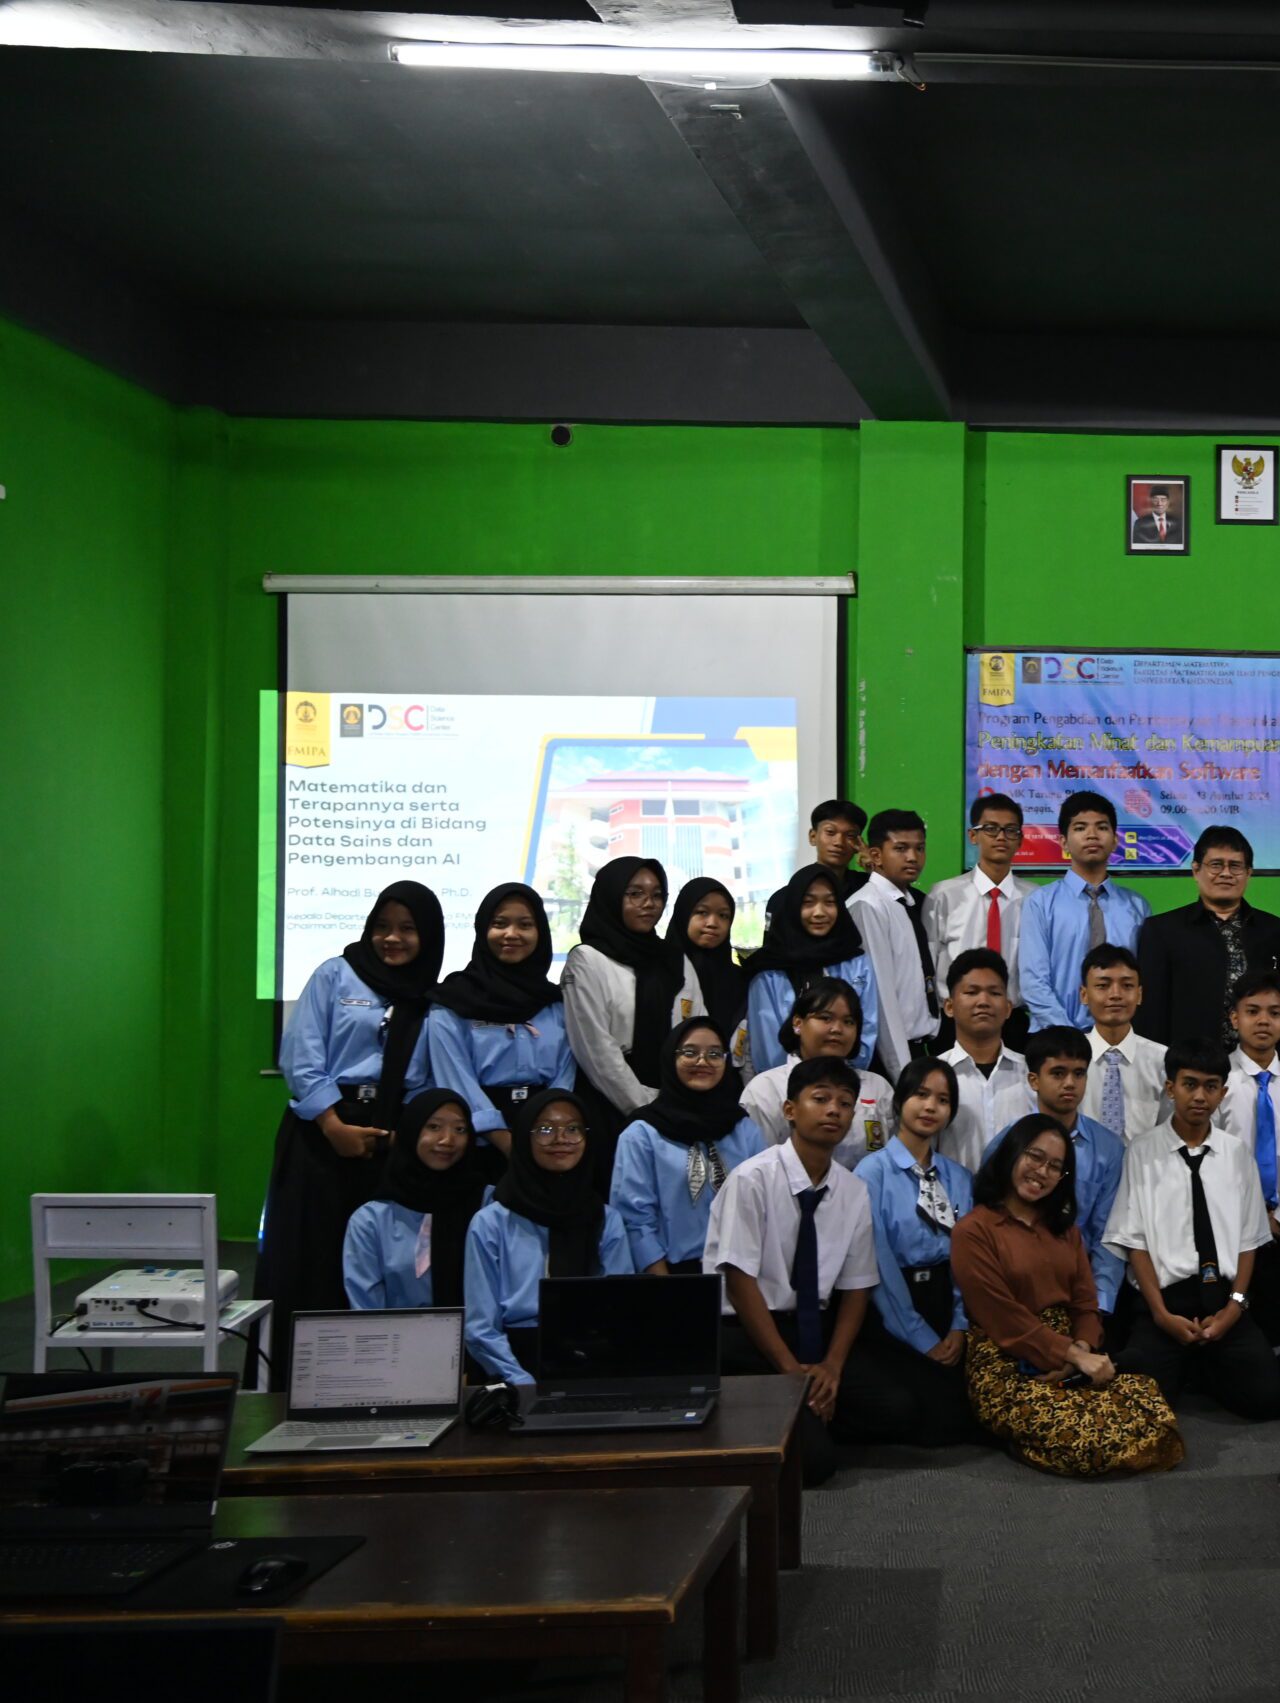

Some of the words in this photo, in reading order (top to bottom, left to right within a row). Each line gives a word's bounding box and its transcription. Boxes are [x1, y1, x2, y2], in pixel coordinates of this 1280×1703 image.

[1044, 657, 1096, 679] DSC
[982, 688, 1012, 697] FMIPA
[367, 704, 425, 731] DSC
[978, 712, 1029, 727] Program
[288, 745, 327, 757] FMIPA
[977, 731, 1085, 756] Peningkatan
[1089, 732, 1139, 751] Minat
[1145, 732, 1176, 751] dan
[976, 760, 1042, 784] dengan
[1047, 759, 1174, 780] Memanfaatkan
[1178, 760, 1262, 781] Software
[288, 780, 407, 793] Matematika
[411, 781, 448, 794] dan
[288, 798, 404, 813] Terapannya
[409, 801, 460, 812] serta
[288, 816, 396, 831] Potensinya
[400, 817, 417, 829] di
[421, 817, 487, 831] Bidang
[288, 834, 336, 846] Data
[340, 835, 393, 847] Sains
[397, 835, 433, 847] dan
[288, 852, 438, 868] Pengembangan
[442, 853, 461, 865] AI
[287, 887, 320, 898] Prof.
[321, 887, 361, 898] Alhadi
